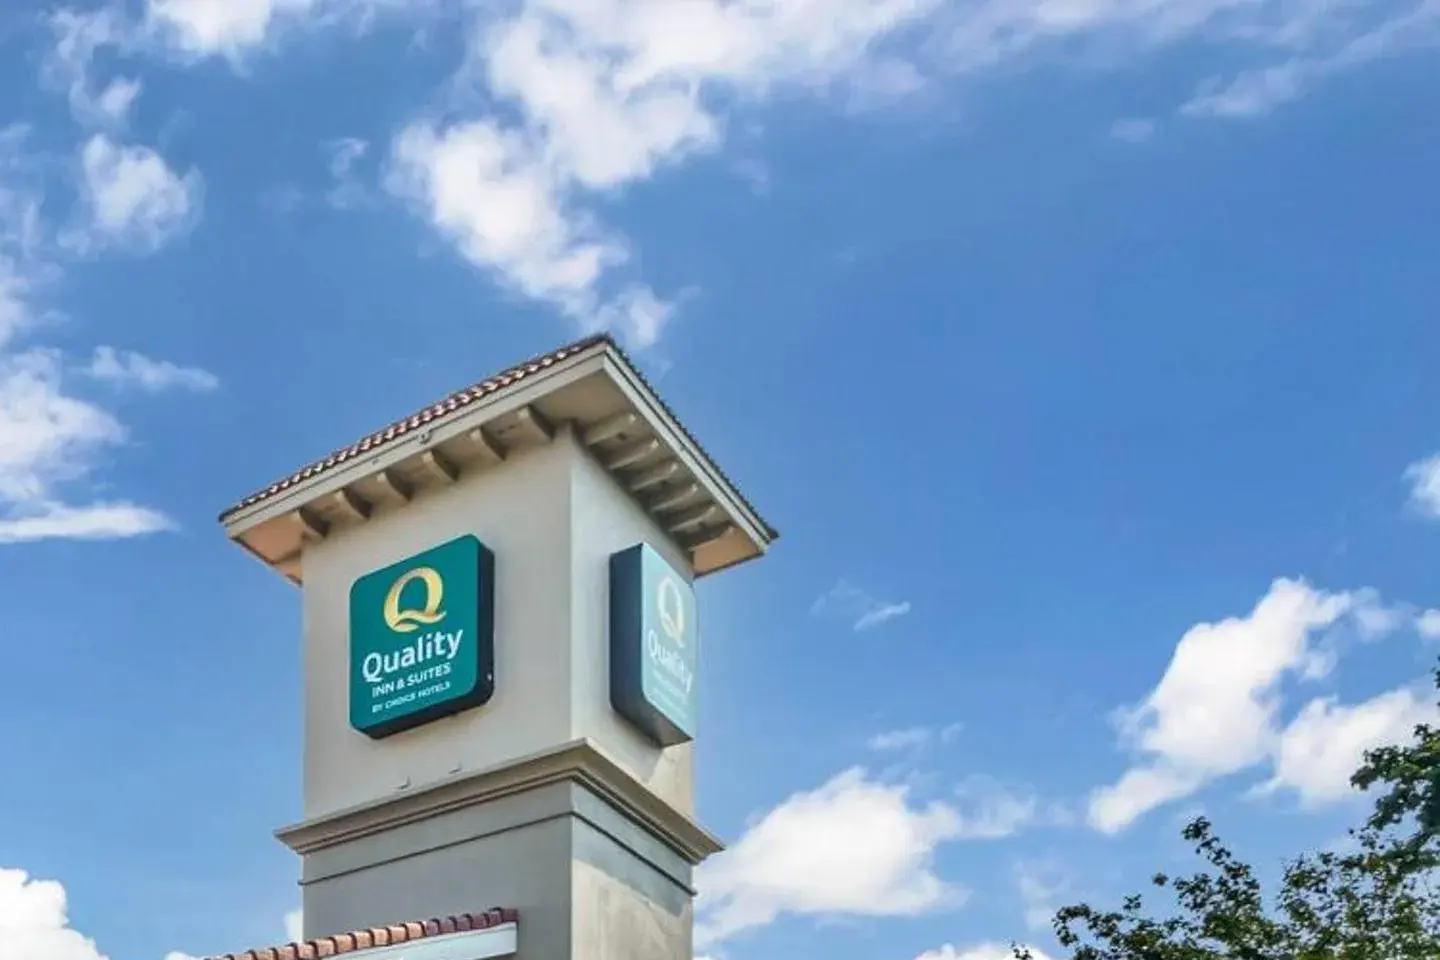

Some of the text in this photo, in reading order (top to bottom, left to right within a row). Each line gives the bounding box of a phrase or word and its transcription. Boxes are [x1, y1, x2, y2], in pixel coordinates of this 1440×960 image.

[384, 567, 447, 632] Q
[657, 577, 685, 648] Q
[362, 629, 464, 682] Quality
[372, 662, 452, 698] INN & SUITES
